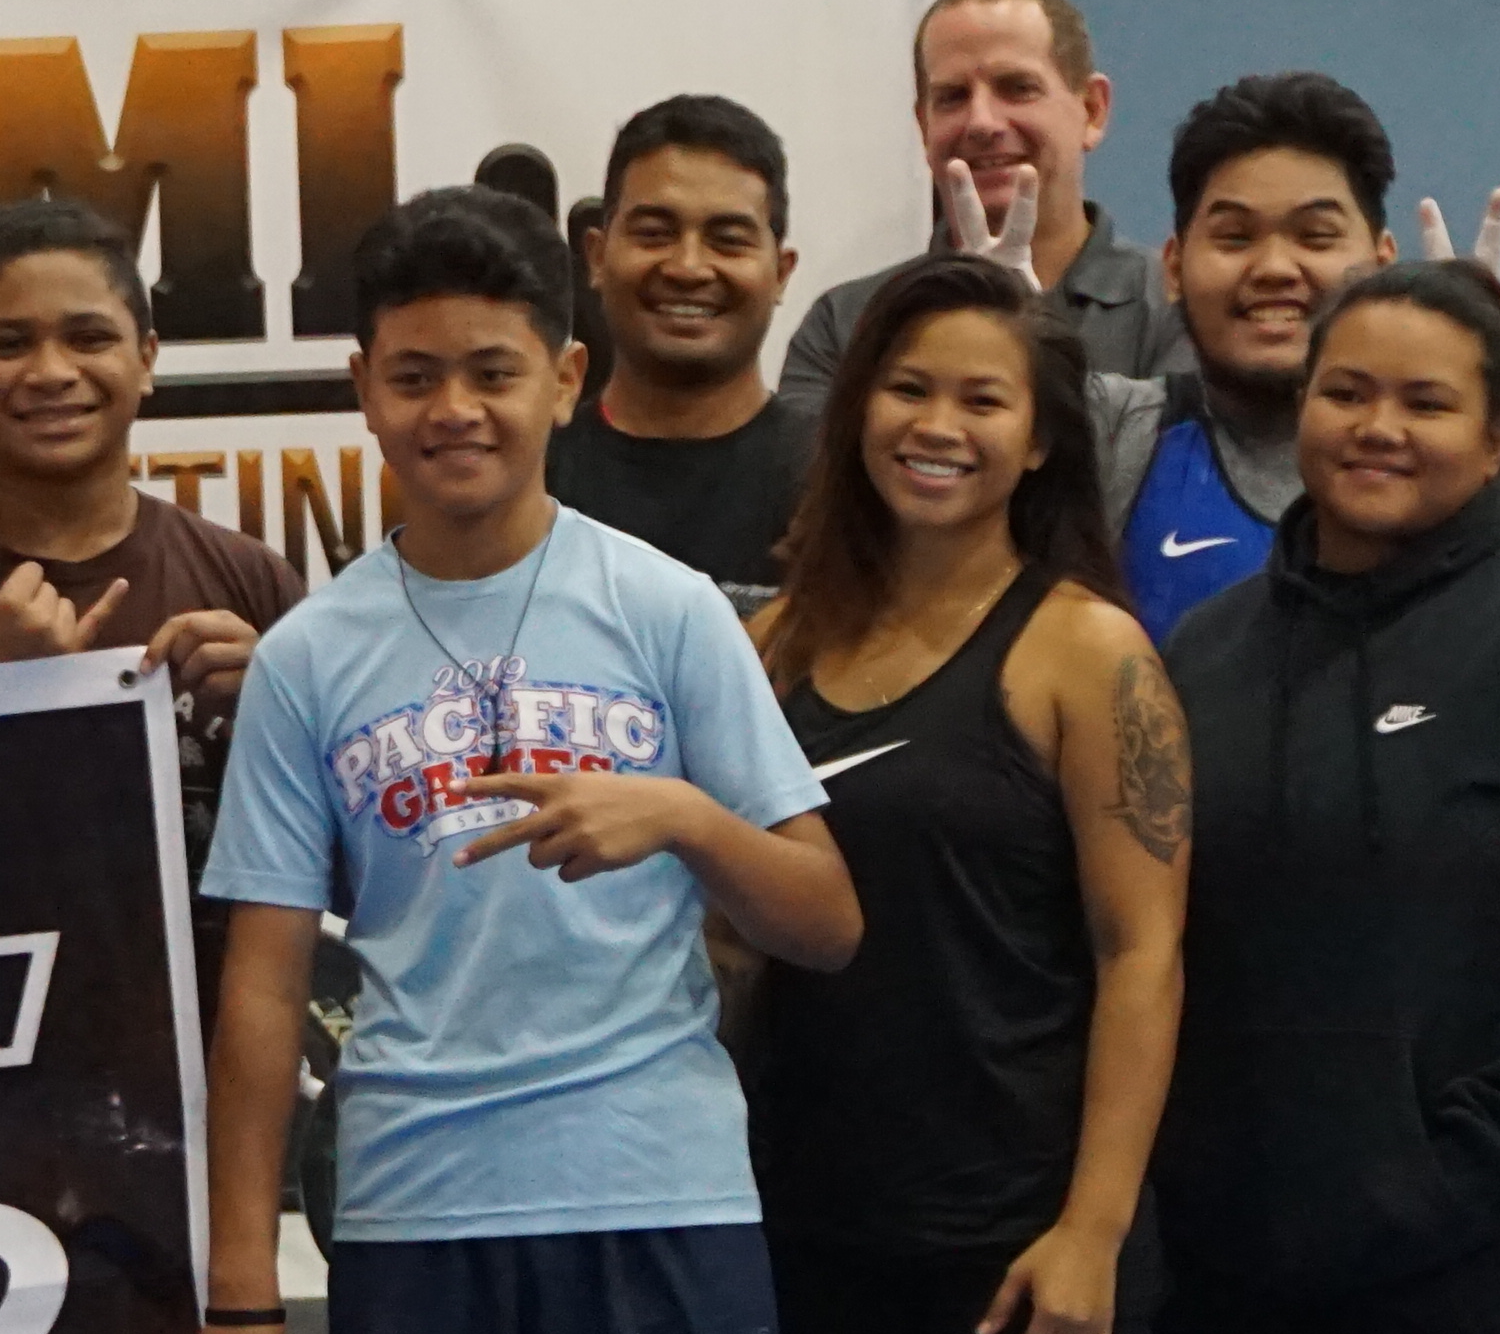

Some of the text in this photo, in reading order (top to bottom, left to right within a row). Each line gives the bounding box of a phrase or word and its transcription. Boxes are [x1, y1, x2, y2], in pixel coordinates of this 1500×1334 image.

[431, 655, 528, 698] 2019
[1386, 704, 1427, 722] NIKE
[456, 803, 521, 828] SAMO
